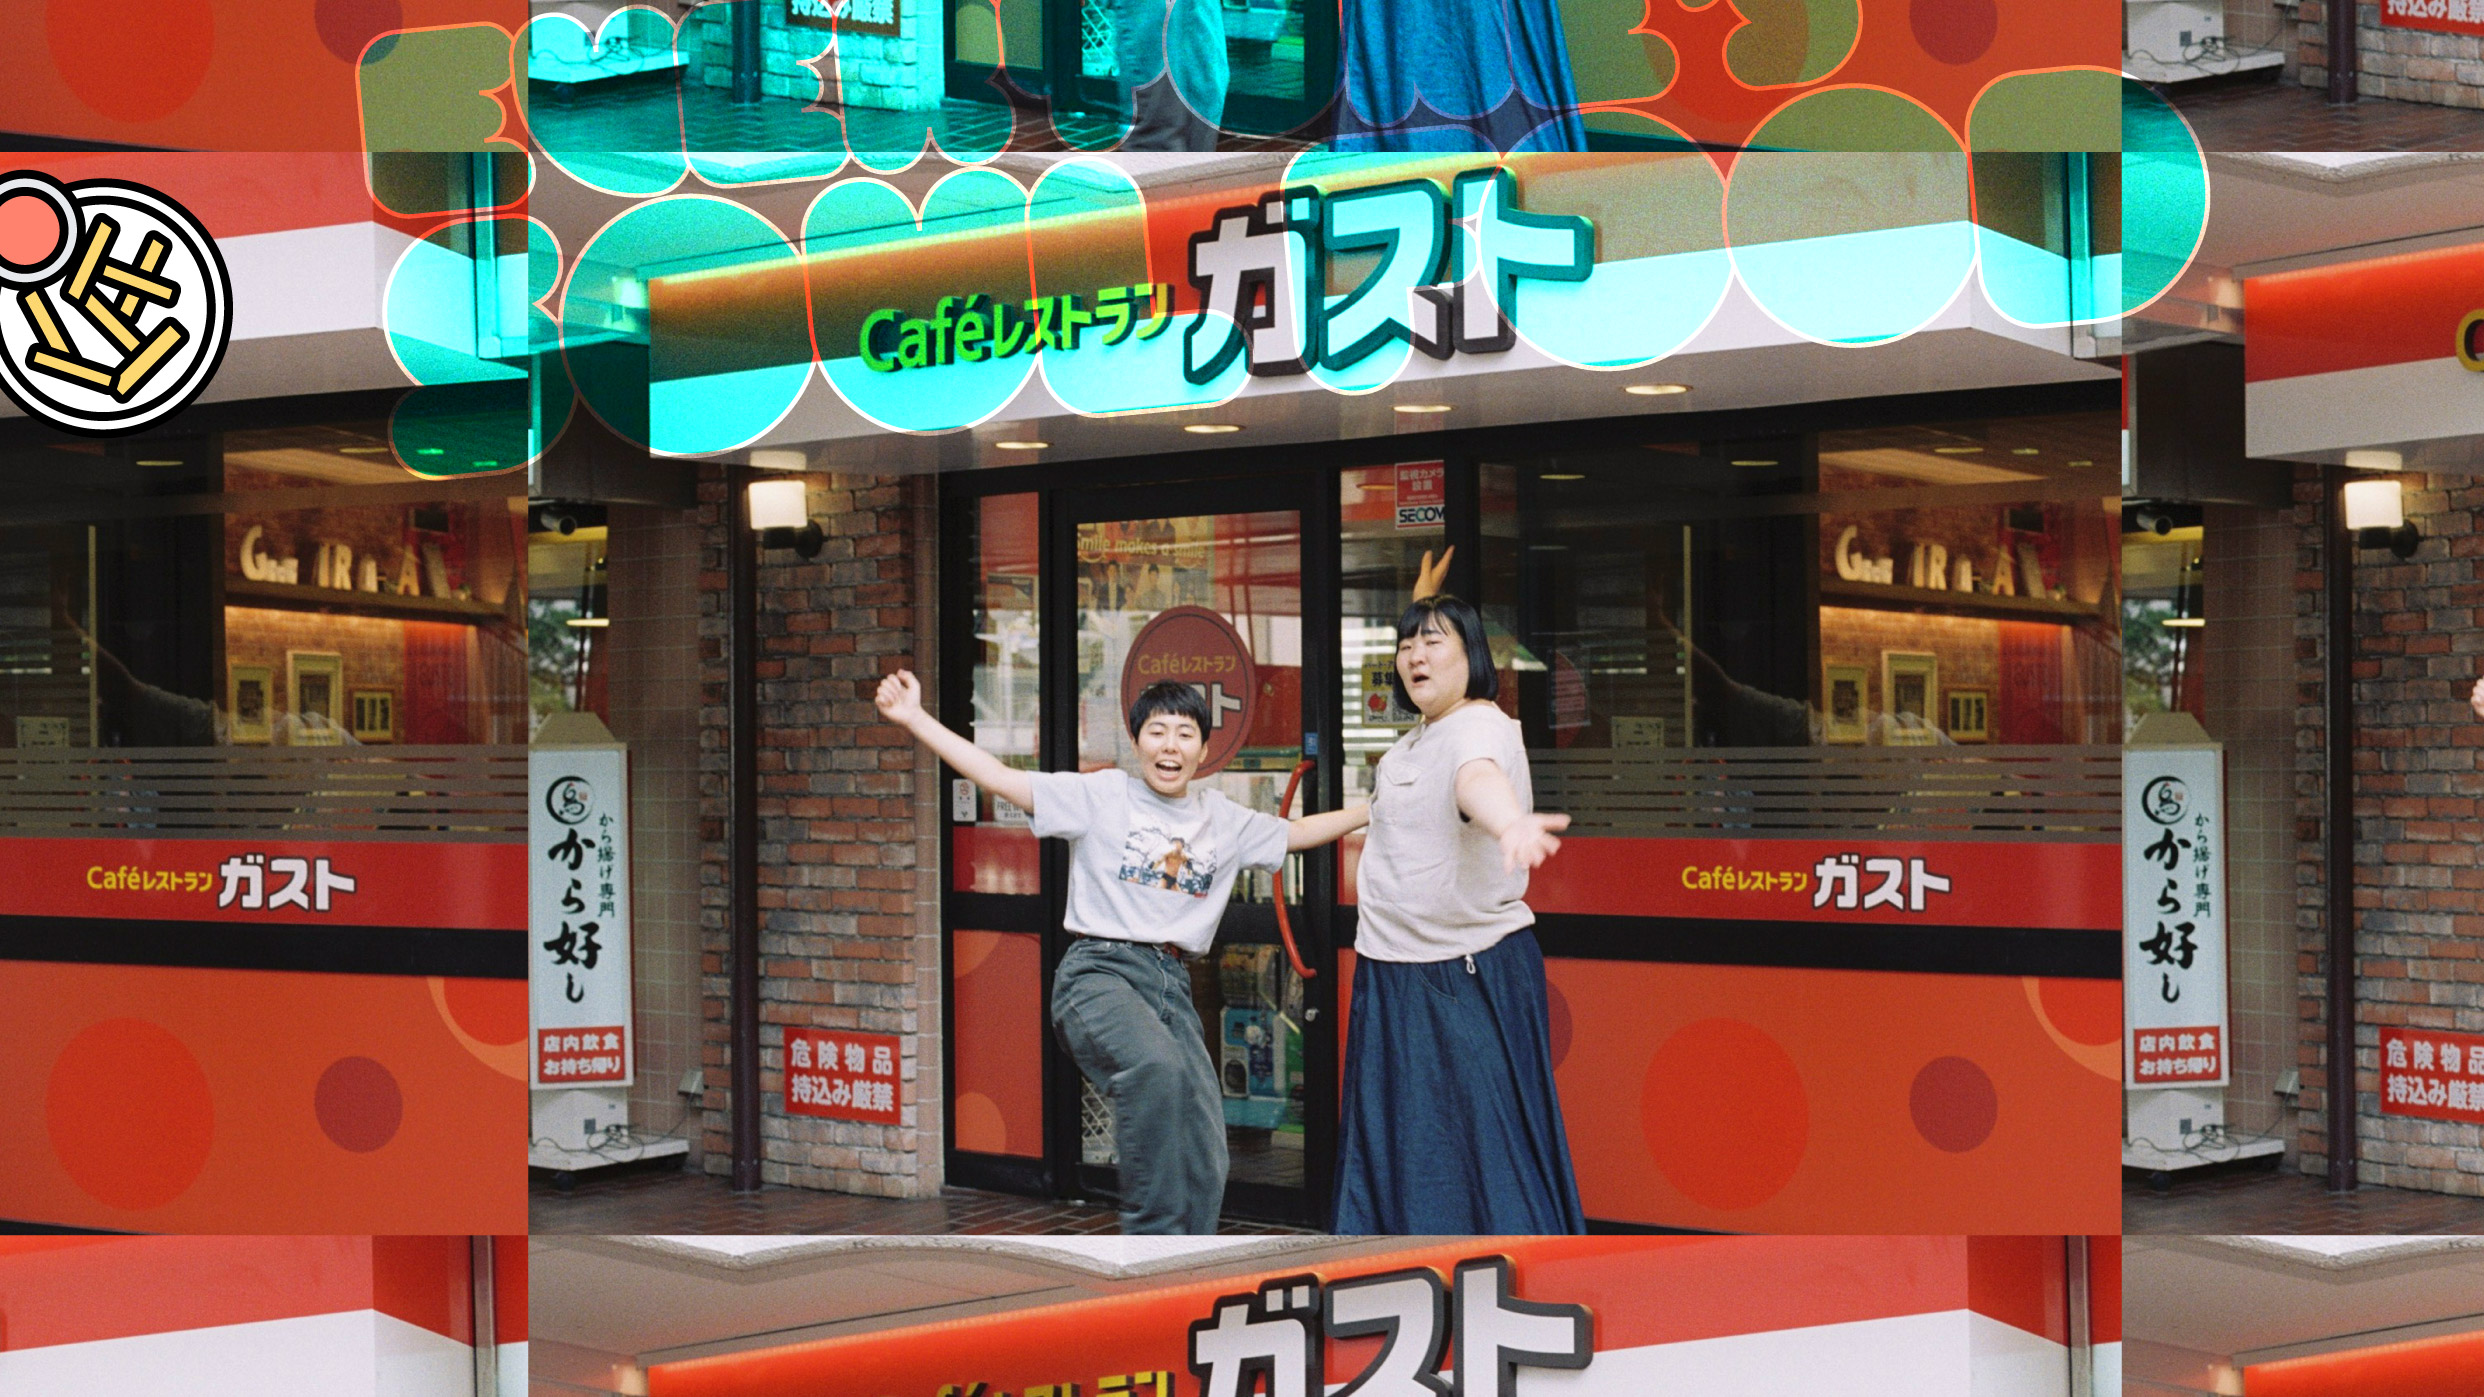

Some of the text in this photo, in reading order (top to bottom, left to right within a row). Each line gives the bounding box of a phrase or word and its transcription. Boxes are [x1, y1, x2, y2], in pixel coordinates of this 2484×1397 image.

[859, 166, 1595, 386] Caféレストラン ガスト
[1115, 537, 1158, 555] makes
[1137, 653, 1237, 675] Caféレストラン
[87, 853, 357, 912] Caféレストラン ガスト
[597, 813, 616, 918] から揚げ専門
[1681, 852, 1951, 912] Caféレストラン ガスト
[2193, 813, 2211, 918] から揚げ専門
[543, 828, 603, 1004] から好し
[2139, 828, 2198, 1004] から好し
[543, 1033, 620, 1052] 店内飲食
[790, 1037, 893, 1076] 危険物品
[2138, 1033, 2216, 1052] 店内飲食
[543, 1056, 621, 1076] お持ち帰り
[2138, 1056, 2216, 1076] お持ち帰り
[791, 1073, 894, 1112] 持込み厳禁
